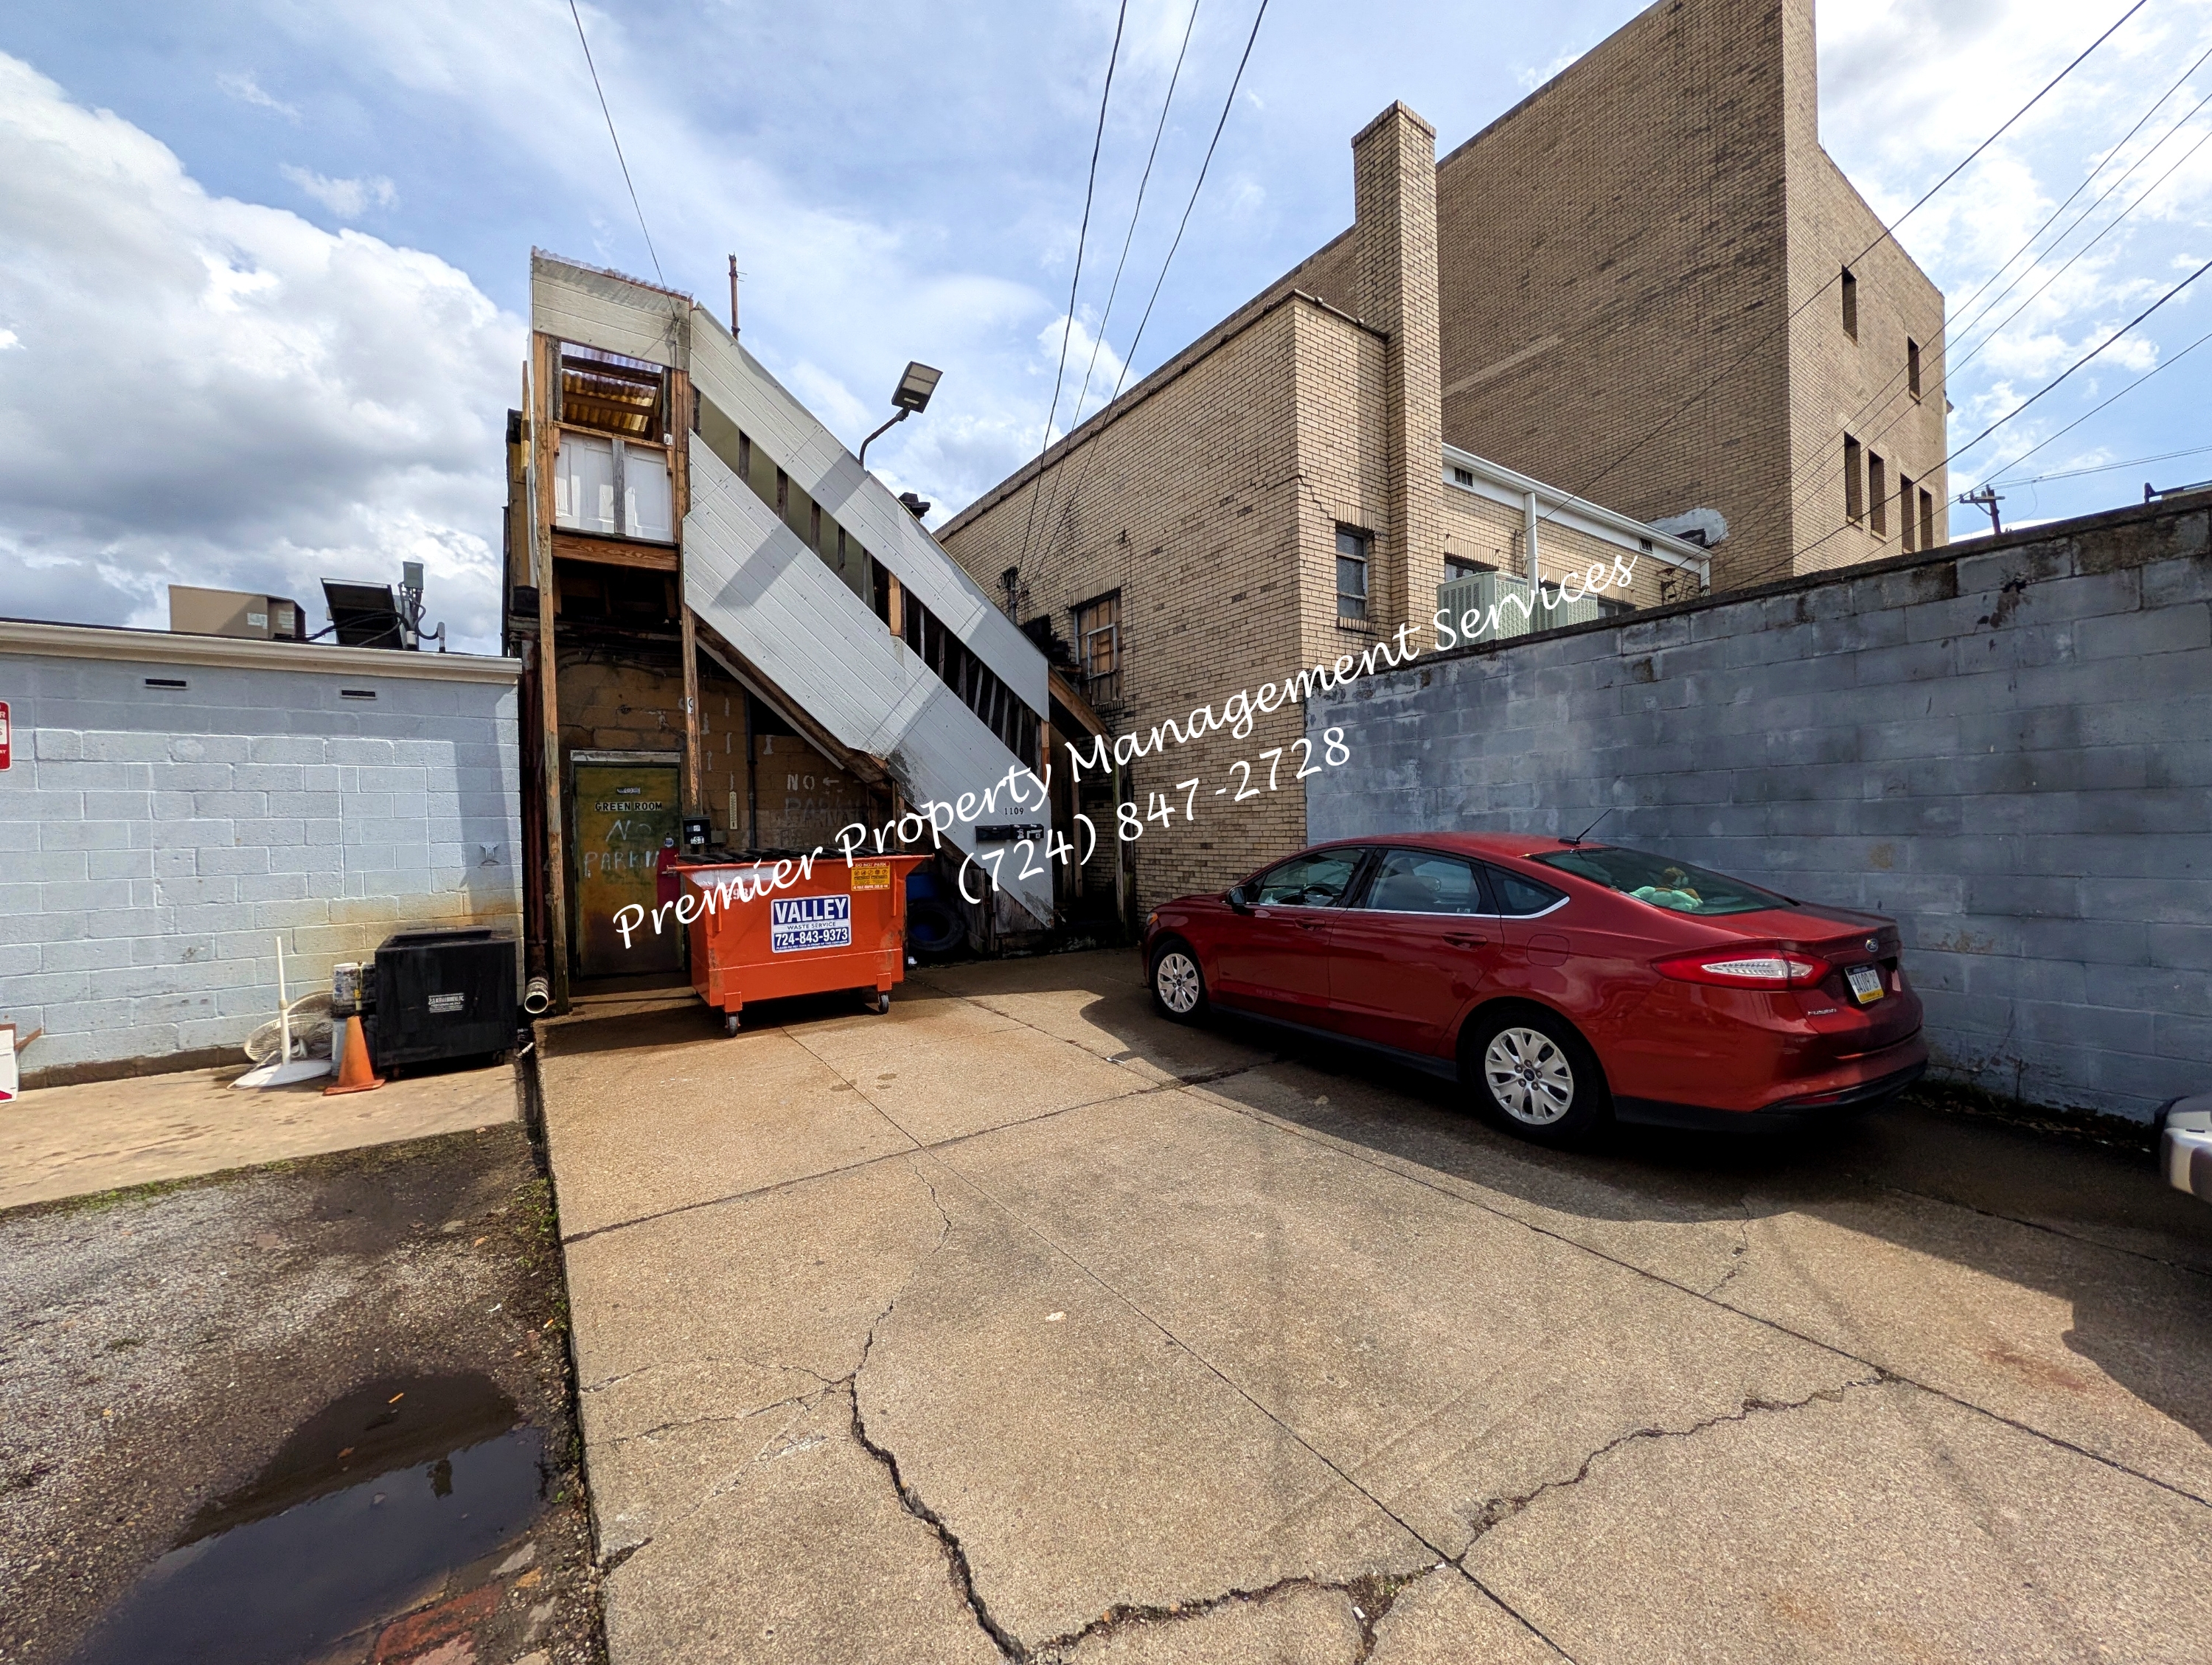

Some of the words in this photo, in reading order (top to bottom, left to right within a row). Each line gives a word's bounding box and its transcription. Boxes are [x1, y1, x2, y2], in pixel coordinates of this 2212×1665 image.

[787, 774, 815, 790] NO
[595, 802, 631, 811] GREEN
[634, 802, 663, 810] ROOM
[1004, 807, 1024, 816] 1109
[605, 819, 652, 842] NO
[775, 898, 846, 923] VALLEY
[775, 928, 848, 946] 724-843-9373
